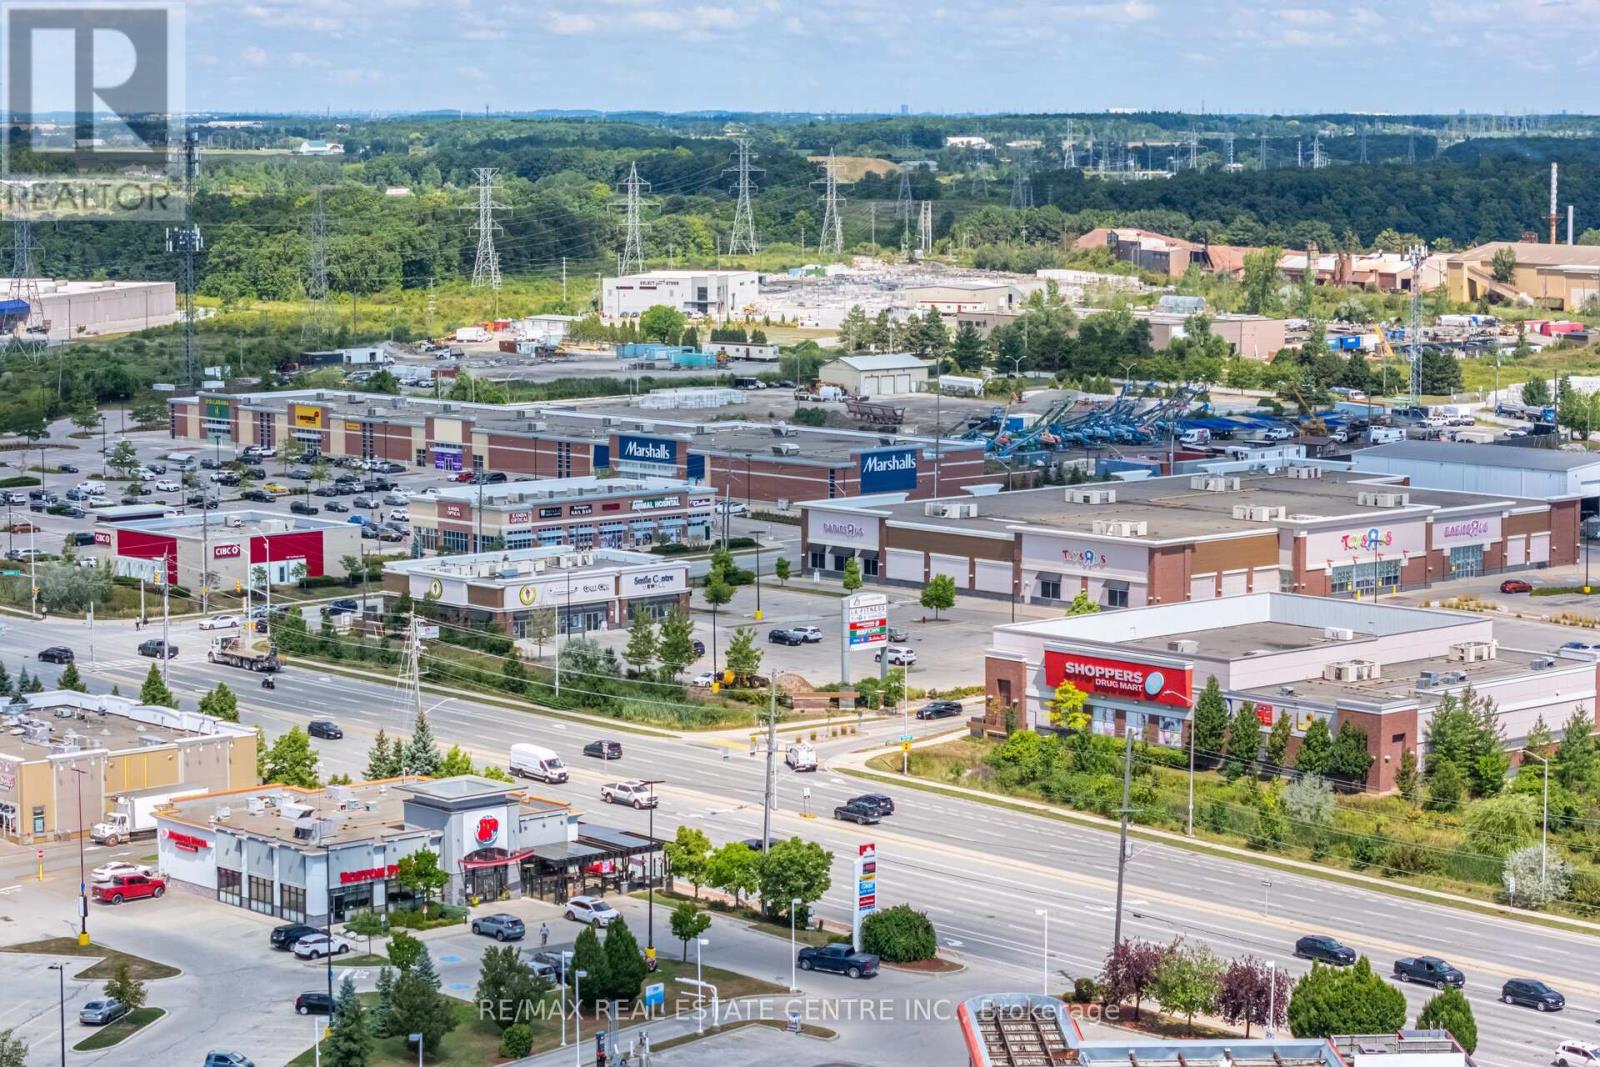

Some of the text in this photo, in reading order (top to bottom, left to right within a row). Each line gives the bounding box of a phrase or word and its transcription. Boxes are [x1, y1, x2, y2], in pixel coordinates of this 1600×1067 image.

[625, 441, 670, 459] Marshalls
[863, 453, 916, 473] Marshalls
[655, 499, 681, 508] HOSPITAL
[215, 547, 232, 556] CIBC
[653, 574, 674, 583] Cntre
[1065, 662, 1143, 683] SHOPPERS
[1095, 679, 1143, 692] DRUG MART
